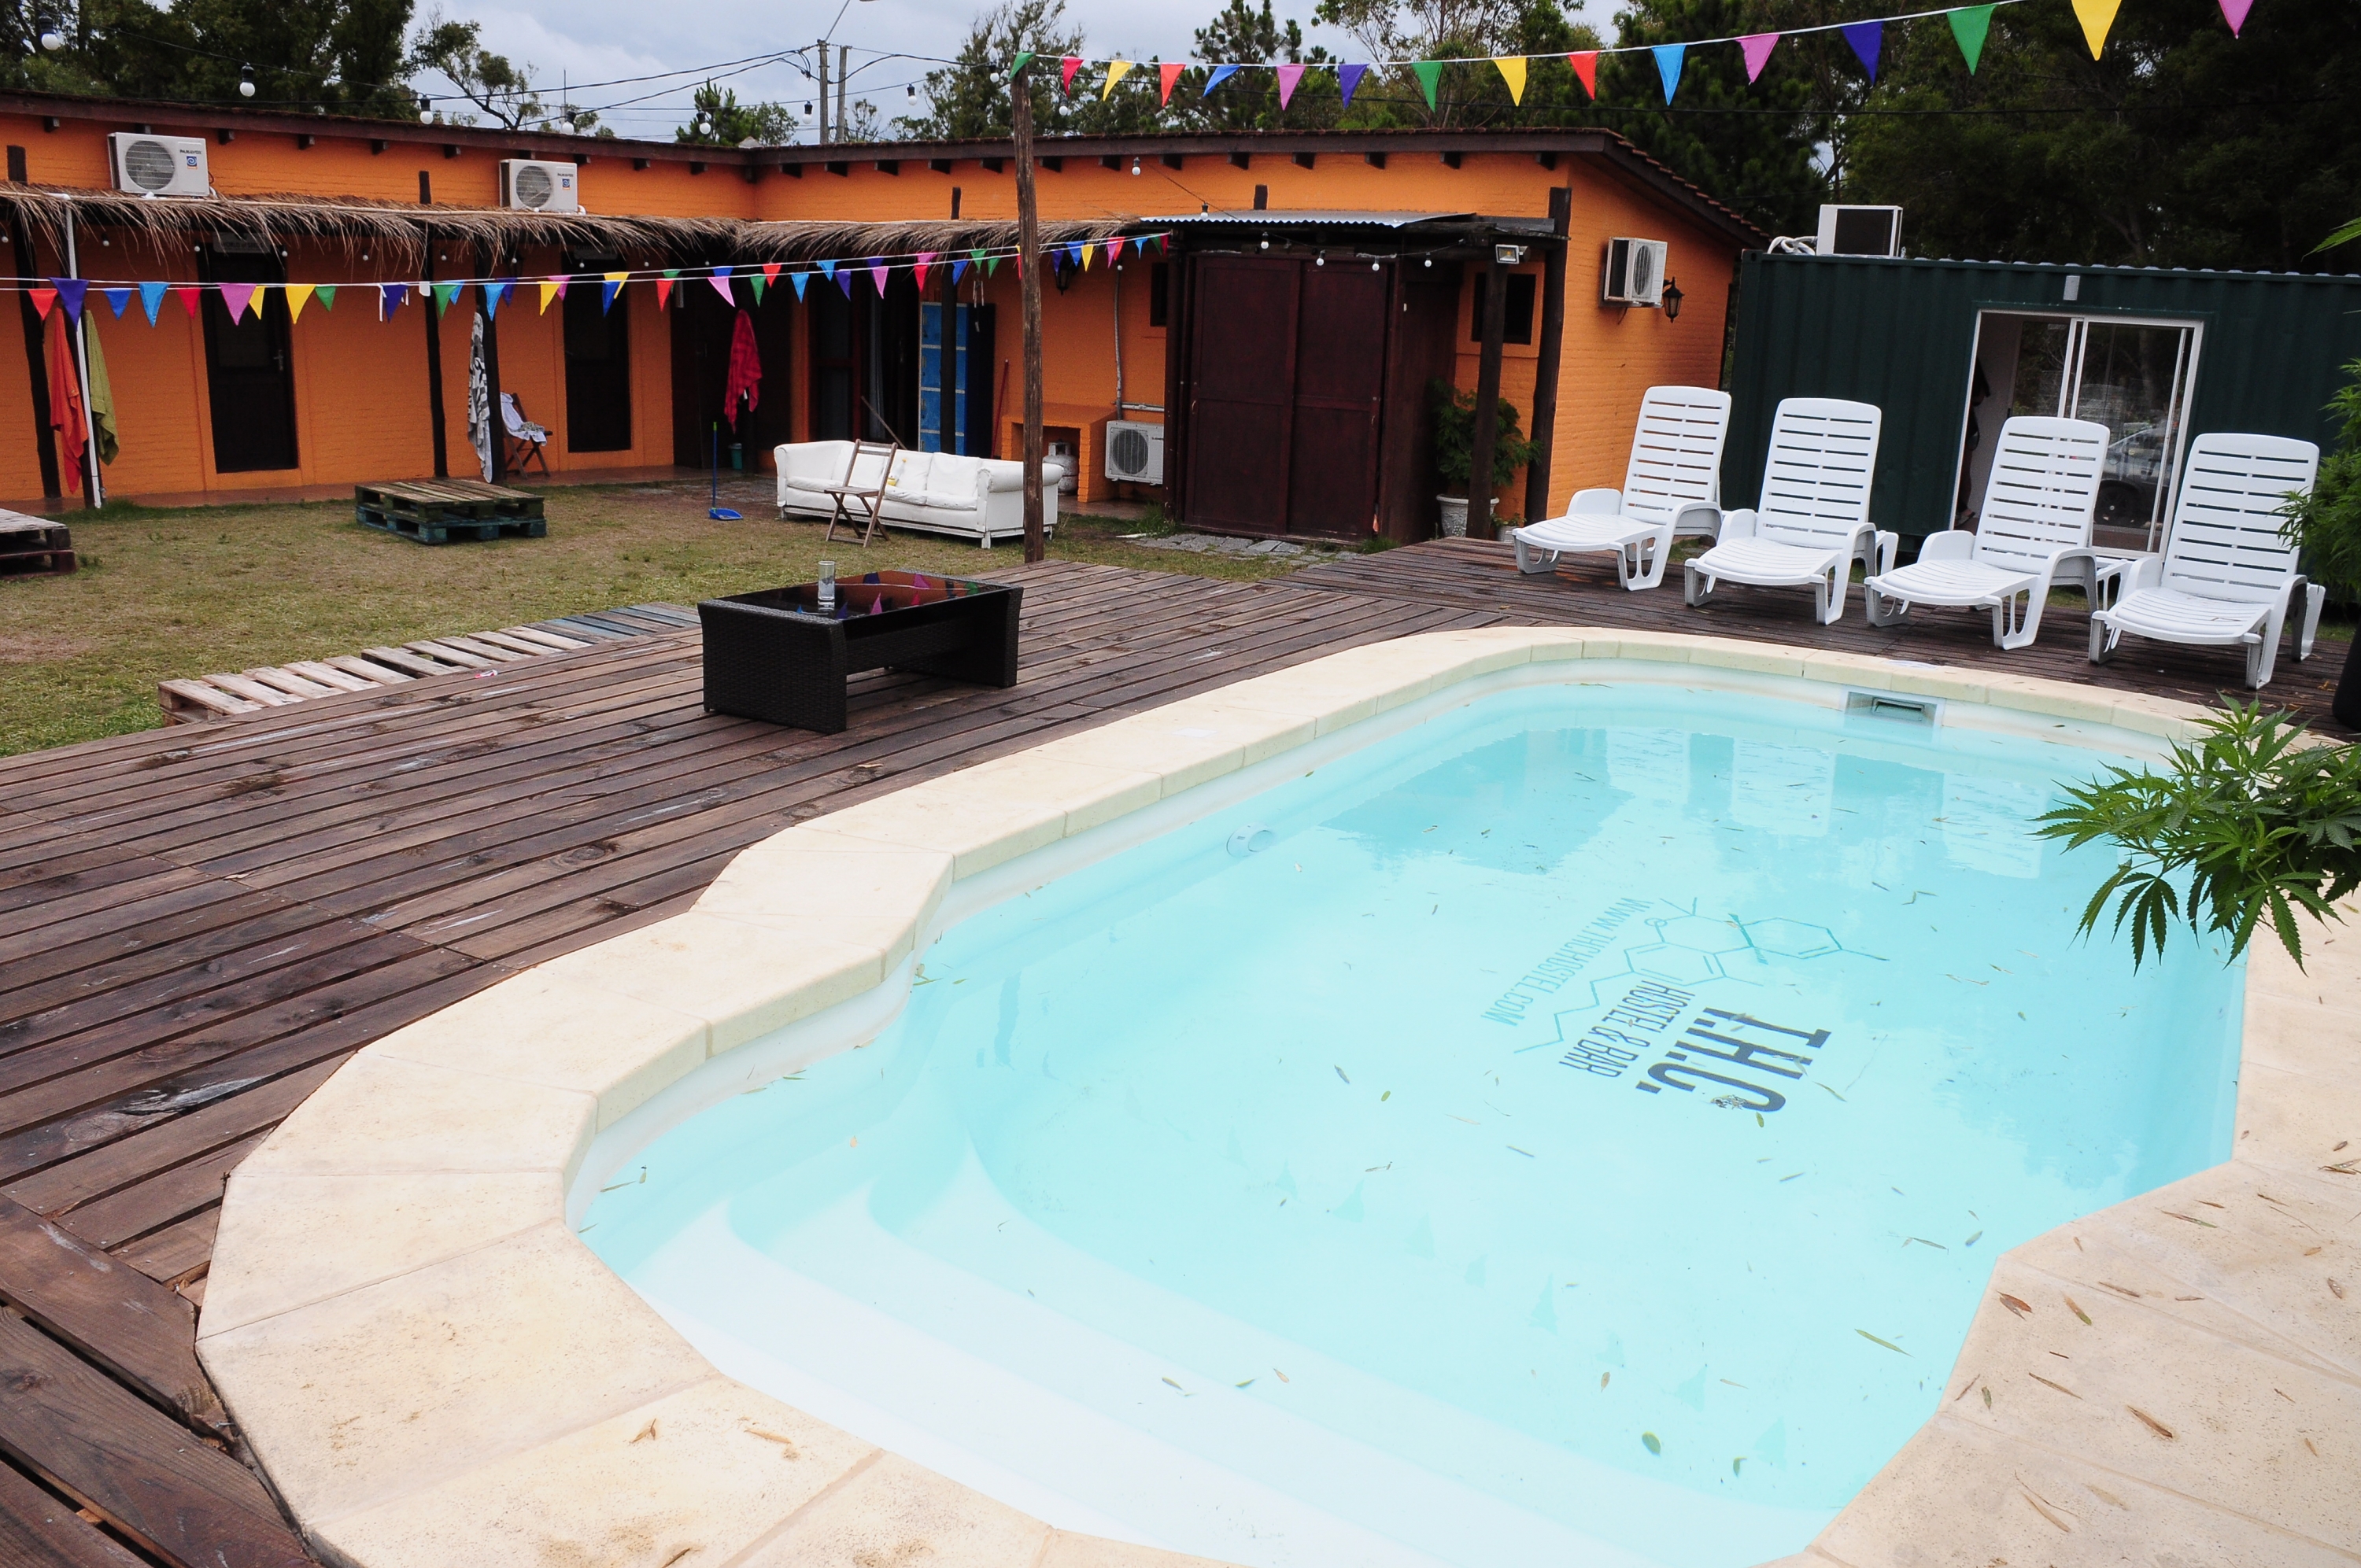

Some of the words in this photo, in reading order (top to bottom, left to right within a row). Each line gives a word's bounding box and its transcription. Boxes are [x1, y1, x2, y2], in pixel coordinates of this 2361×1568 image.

[1480, 897, 1654, 1027] WWW.THCHOSTEL.COM
[1602, 980, 1696, 1033] HOSTEL
[1558, 1038, 1639, 1078] BAR
[1587, 1025, 1651, 1047] &
